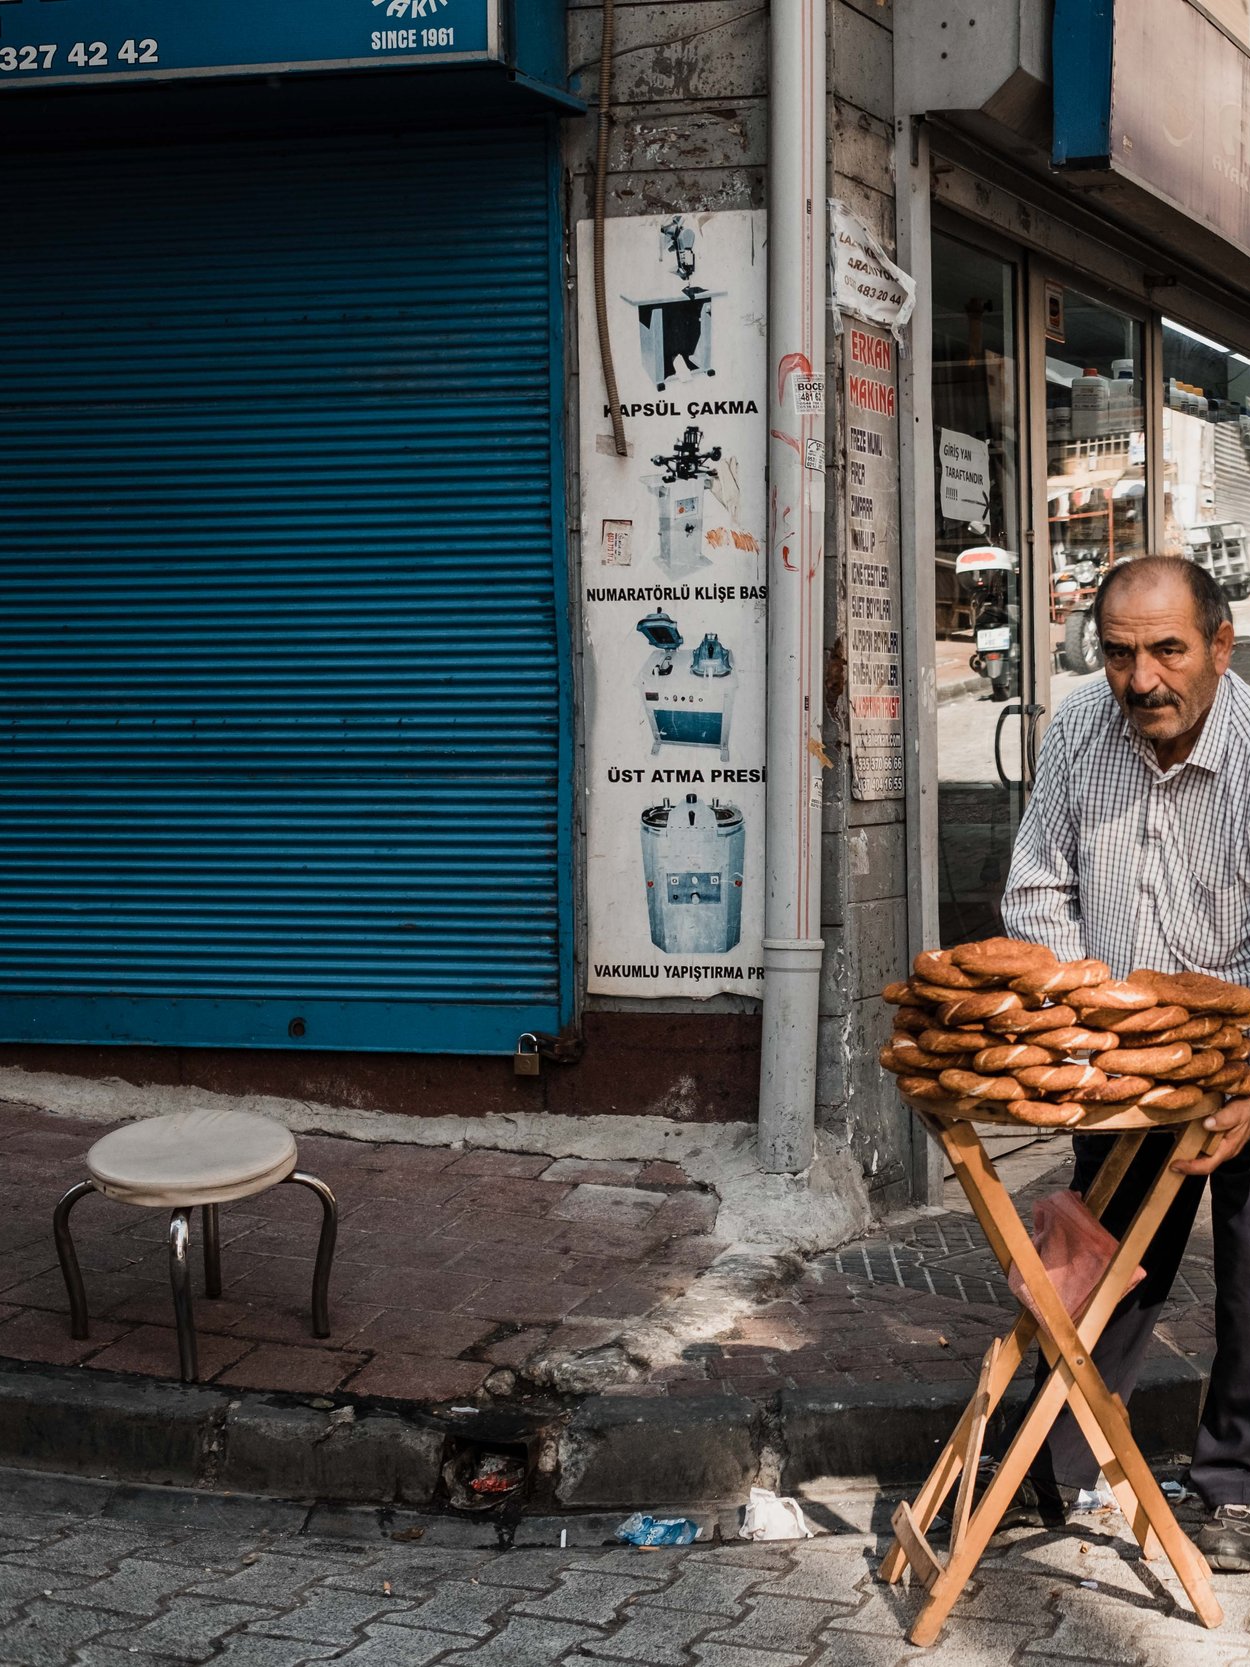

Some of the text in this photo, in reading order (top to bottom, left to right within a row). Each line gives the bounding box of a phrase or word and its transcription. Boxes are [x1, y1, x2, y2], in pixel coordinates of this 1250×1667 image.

[371, 27, 454, 50] SINCE 1961
[0, 39, 159, 71] 327 42 42
[857, 284, 901, 305] 483 20 44
[850, 328, 891, 371] ERKAN
[603, 400, 759, 419] KAPSÜL ÇAKMA
[944, 442, 972, 461] GİRİŞ YAN
[945, 466, 984, 485] TARAFTANDIR
[587, 583, 767, 603] NUMARATÖRLÜ KLİŞE BAS
[856, 756, 870, 771] 535
[893, 755, 902, 770] 66
[608, 766, 767, 783] ÜST ATMA PRESİ
[885, 777, 893, 791] 16
[893, 777, 902, 790] 55
[594, 964, 765, 982] VAKUMLU YAPIŞTIRMA PR
